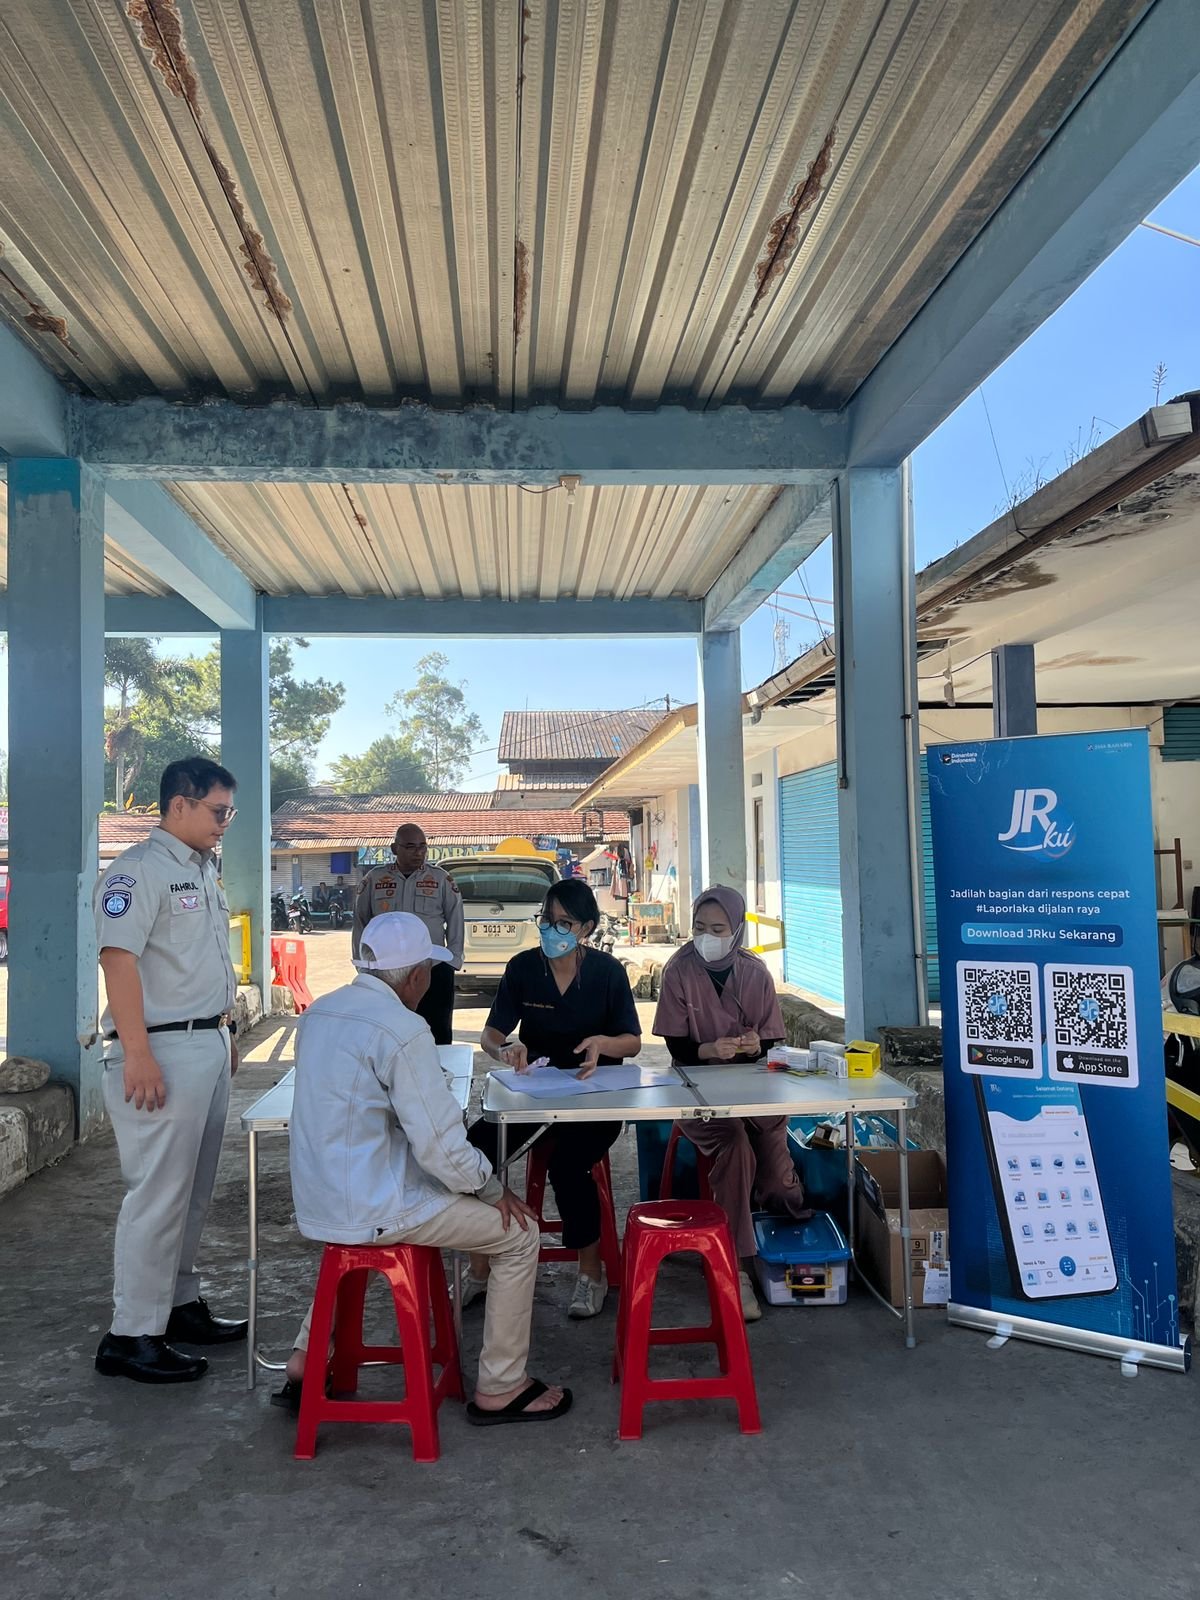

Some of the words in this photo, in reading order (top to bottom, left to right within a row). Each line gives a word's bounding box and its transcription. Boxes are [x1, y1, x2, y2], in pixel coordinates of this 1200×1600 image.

[170, 881, 198, 893] FAHRUL
[950, 889, 986, 898] Jadilah
[988, 889, 1025, 900] bagian
[1027, 889, 1049, 898] dari
[1051, 891, 1095, 900] respons
[1097, 889, 1130, 901] cepat
[976, 904, 1035, 914] #Laporlaka
[1038, 905, 1074, 915] dijalan
[1077, 907, 1101, 915] raya
[472, 924, 478, 933] D
[967, 928, 1024, 939] Download
[1026, 929, 1056, 940] JRku
[1059, 930, 1116, 943] Sekarang
[986, 1054, 1013, 1065] Google
[1014, 1056, 1030, 1066] Play
[1078, 1062, 1096, 1073] App
[1098, 1063, 1122, 1074] Store
